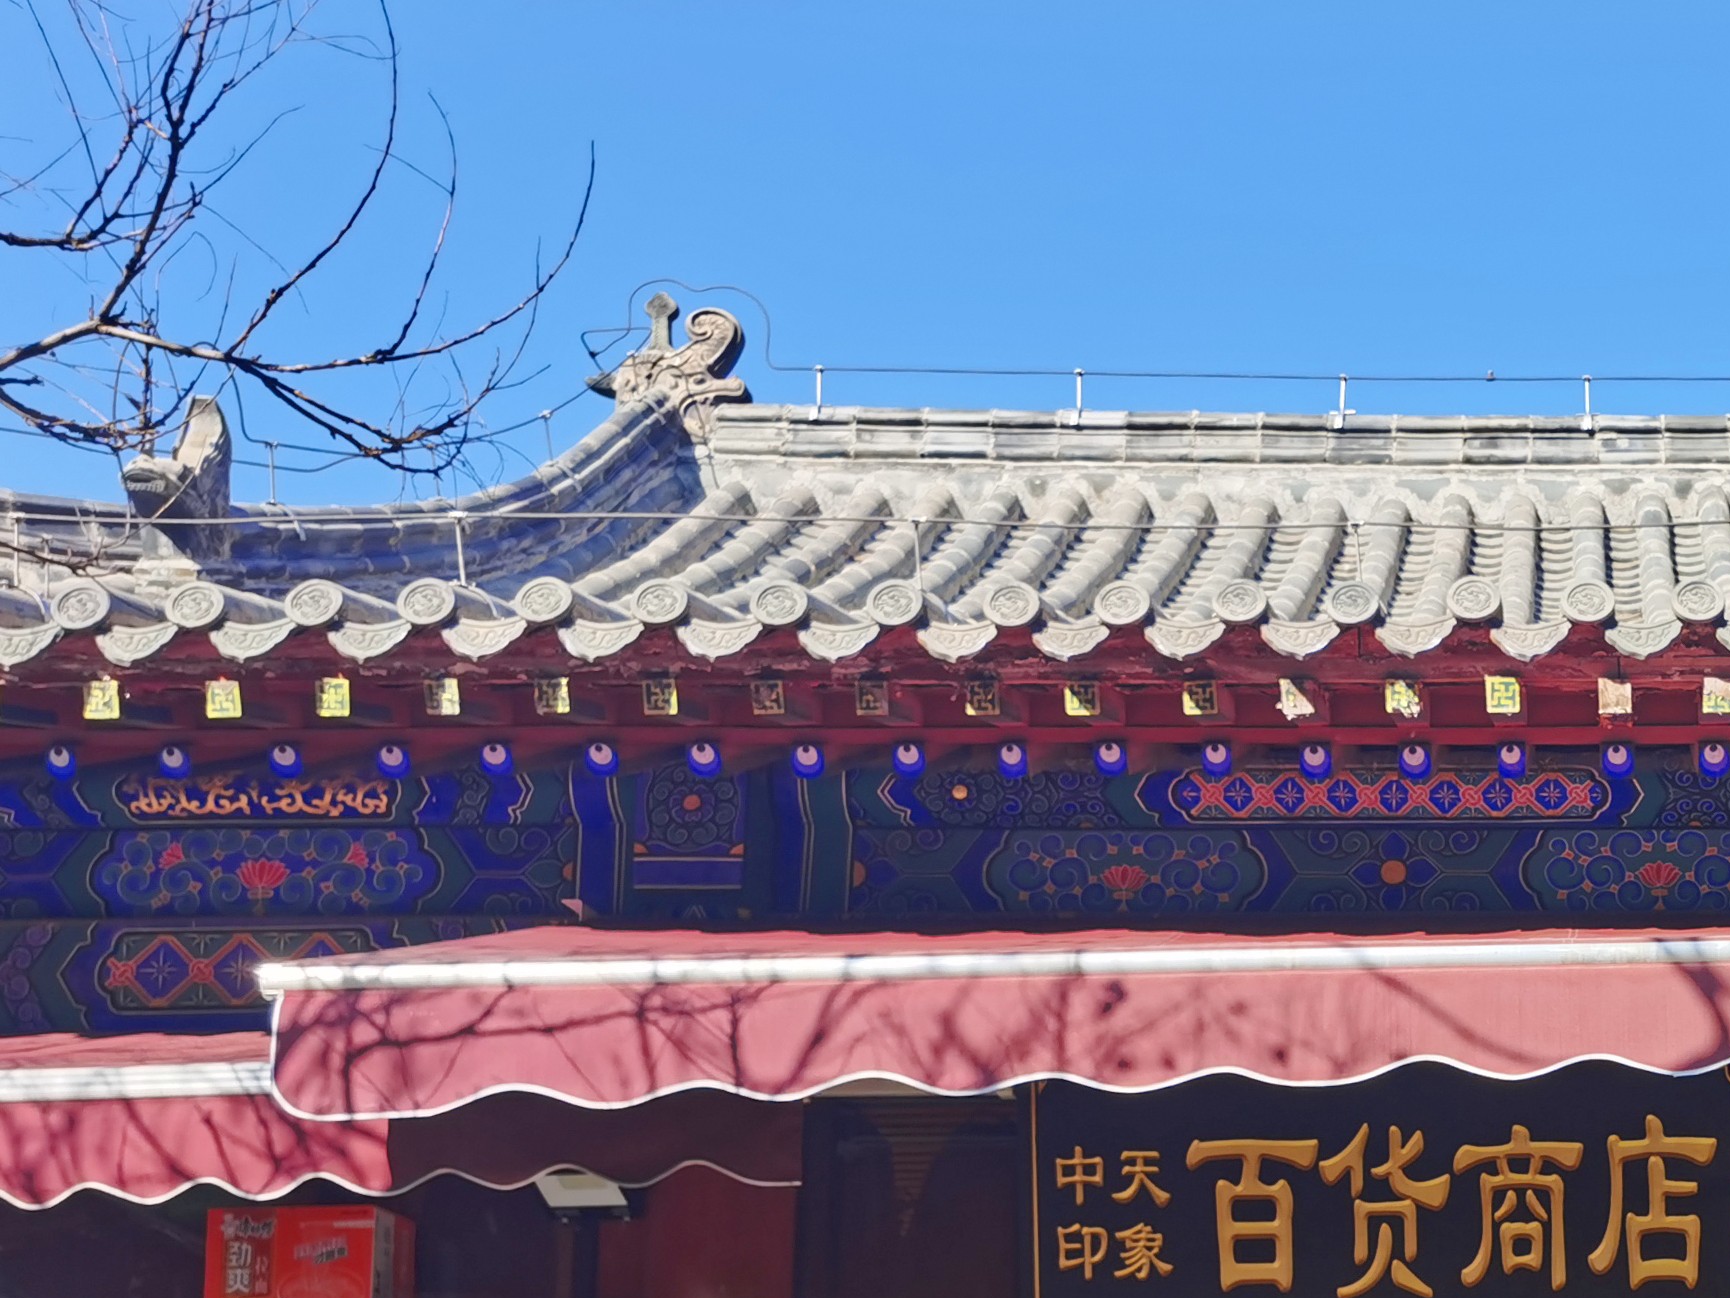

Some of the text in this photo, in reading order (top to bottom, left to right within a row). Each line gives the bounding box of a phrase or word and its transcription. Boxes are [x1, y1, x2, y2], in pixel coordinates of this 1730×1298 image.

[1056, 1146, 1171, 1208] 中天
[1186, 1114, 1718, 1298] 百货商店
[228, 1241, 251, 1295] 劲爽
[1057, 1222, 1174, 1281] 印象
